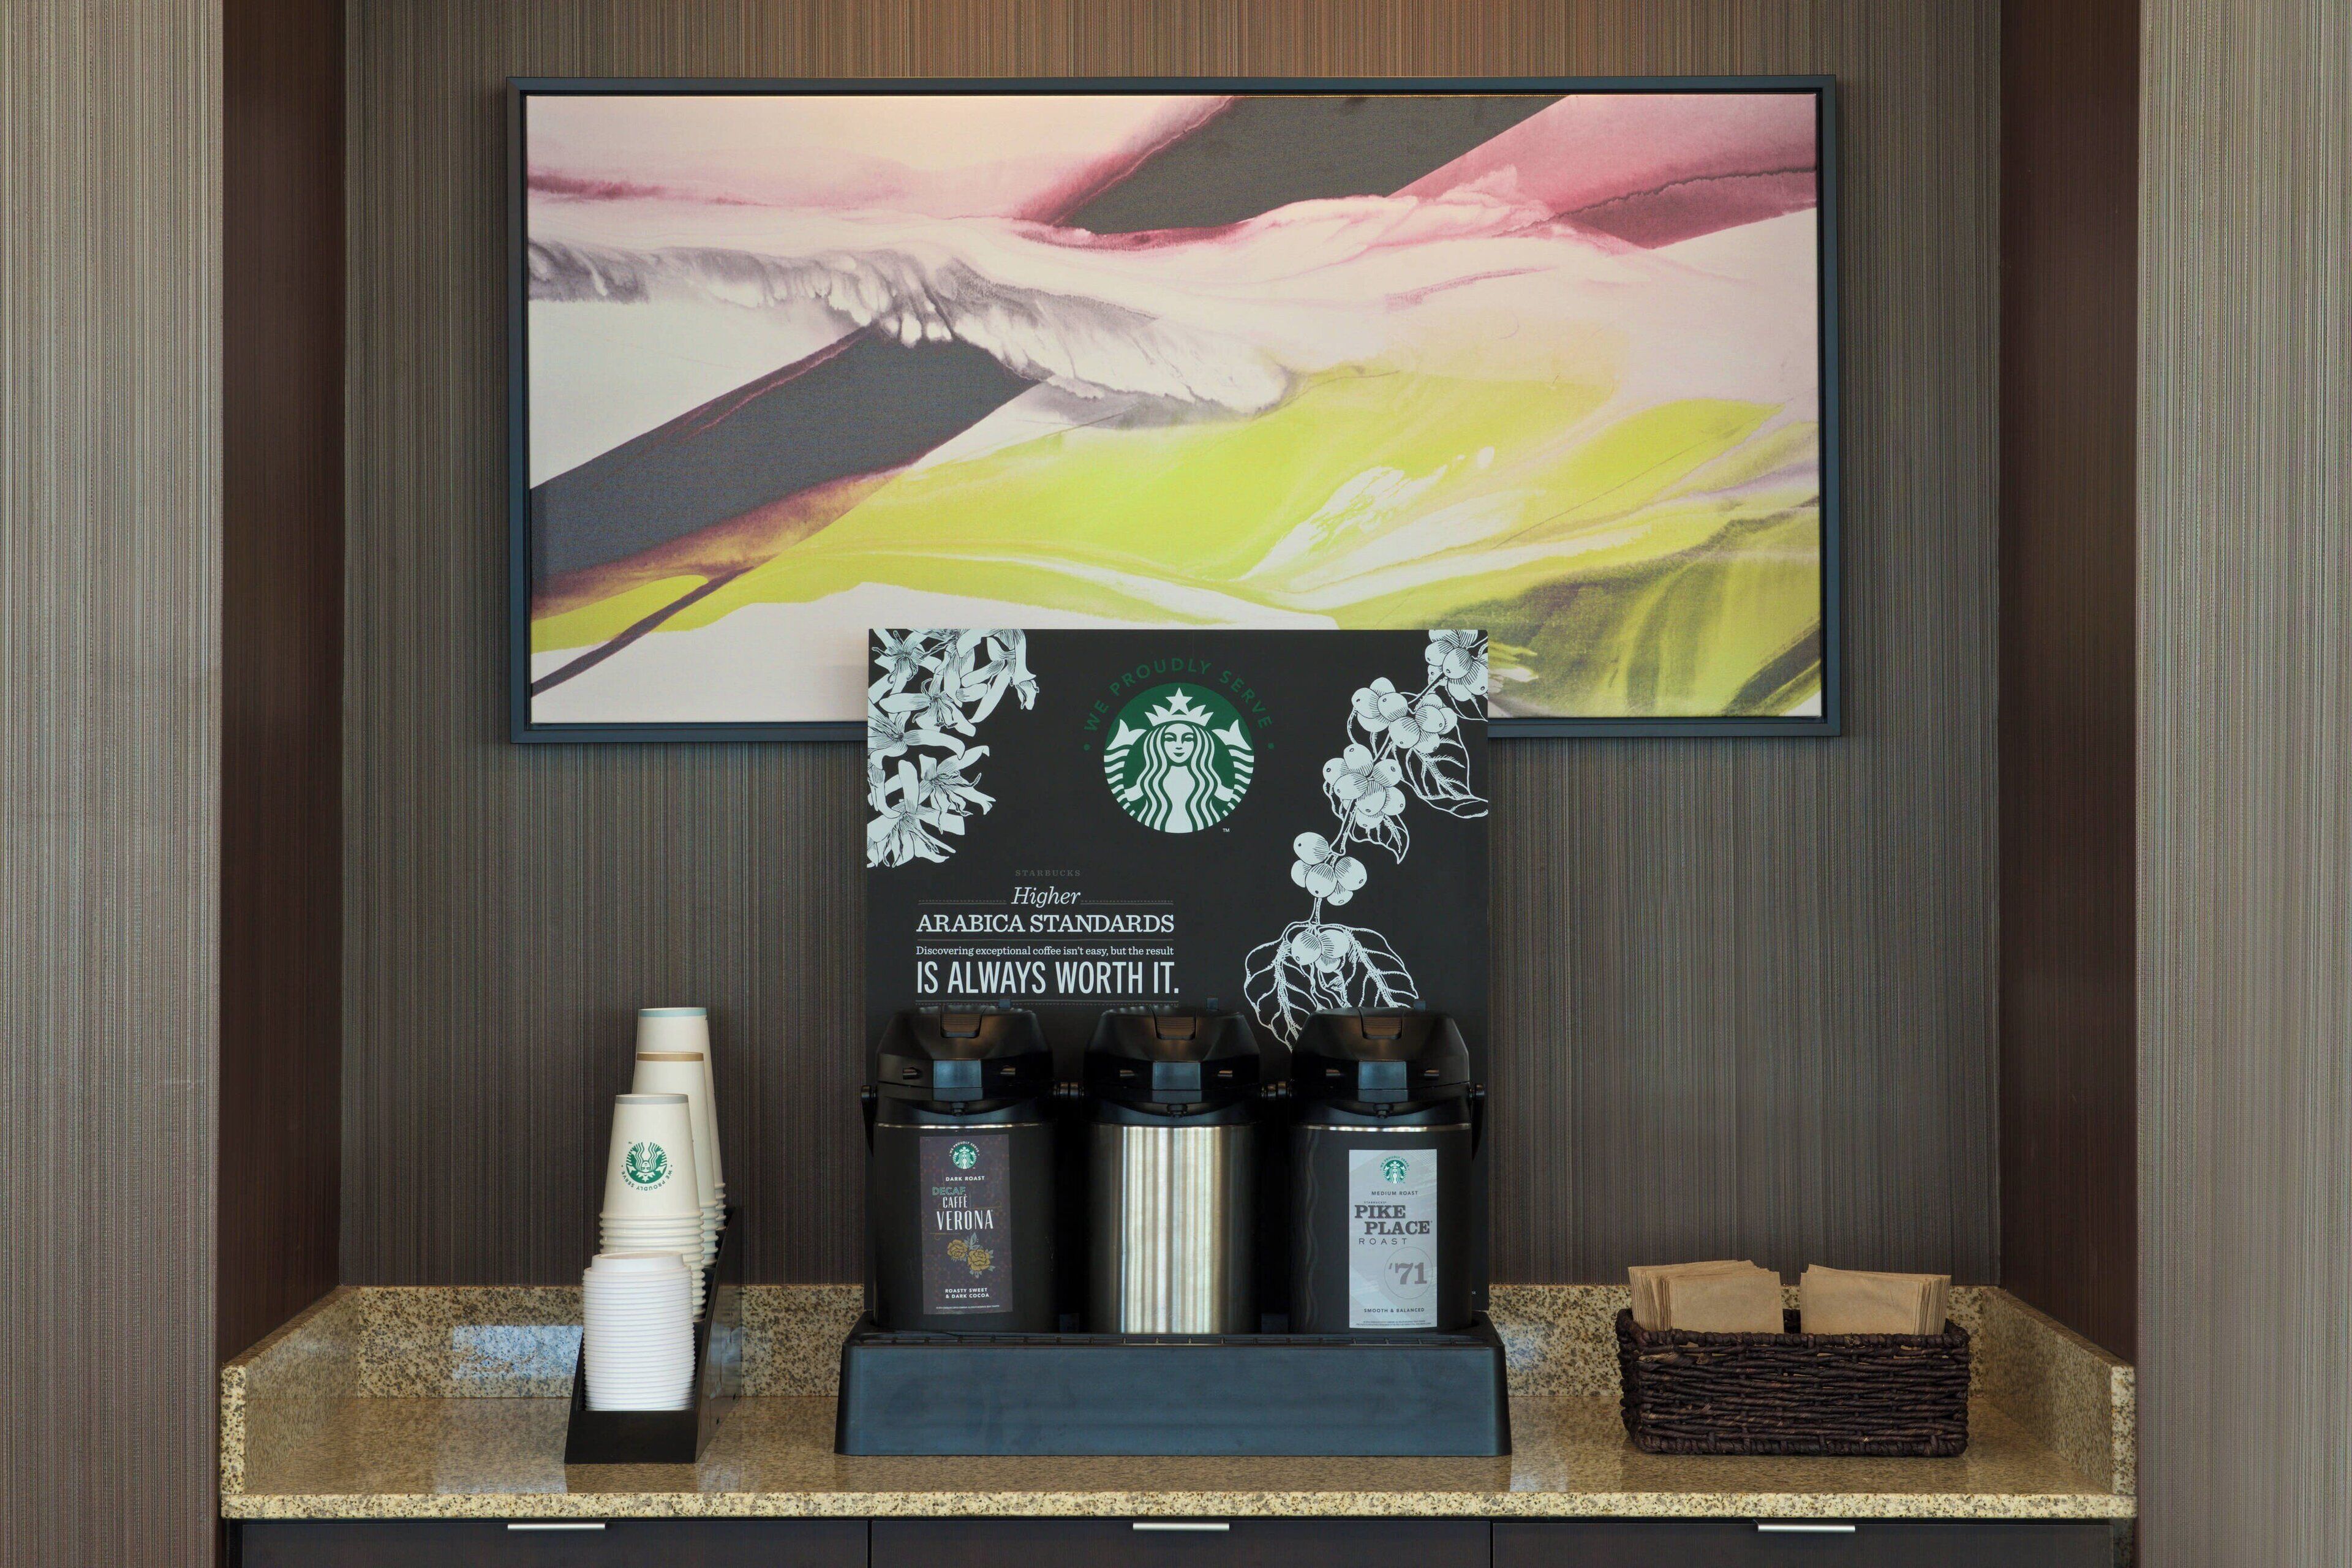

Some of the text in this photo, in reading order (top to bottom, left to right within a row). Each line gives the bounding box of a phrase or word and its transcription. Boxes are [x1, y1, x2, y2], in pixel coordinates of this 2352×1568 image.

[1084, 658, 1273, 731] WE PROUDLY SERVE
[1011, 886, 1081, 908] Higher
[916, 914, 1174, 933] ARABICA STANDARDS
[916, 946, 974, 956] Discovering
[975, 946, 1031, 956] exceptional
[1033, 946, 1061, 956] coffee
[1086, 948, 1109, 957] easy,
[1110, 946, 1126, 956] but
[1128, 946, 1144, 956] the
[1145, 946, 1174, 956] result
[917, 961, 1179, 994] IS ALWAYS WORTH IT.
[621, 1170, 673, 1191] WE PROUDLY SERVE
[932, 1186, 966, 1196] DECAF
[937, 1210, 993, 1231] VERONA
[1354, 1205, 1406, 1218] PIKE
[1365, 1220, 1430, 1235] PLACE
